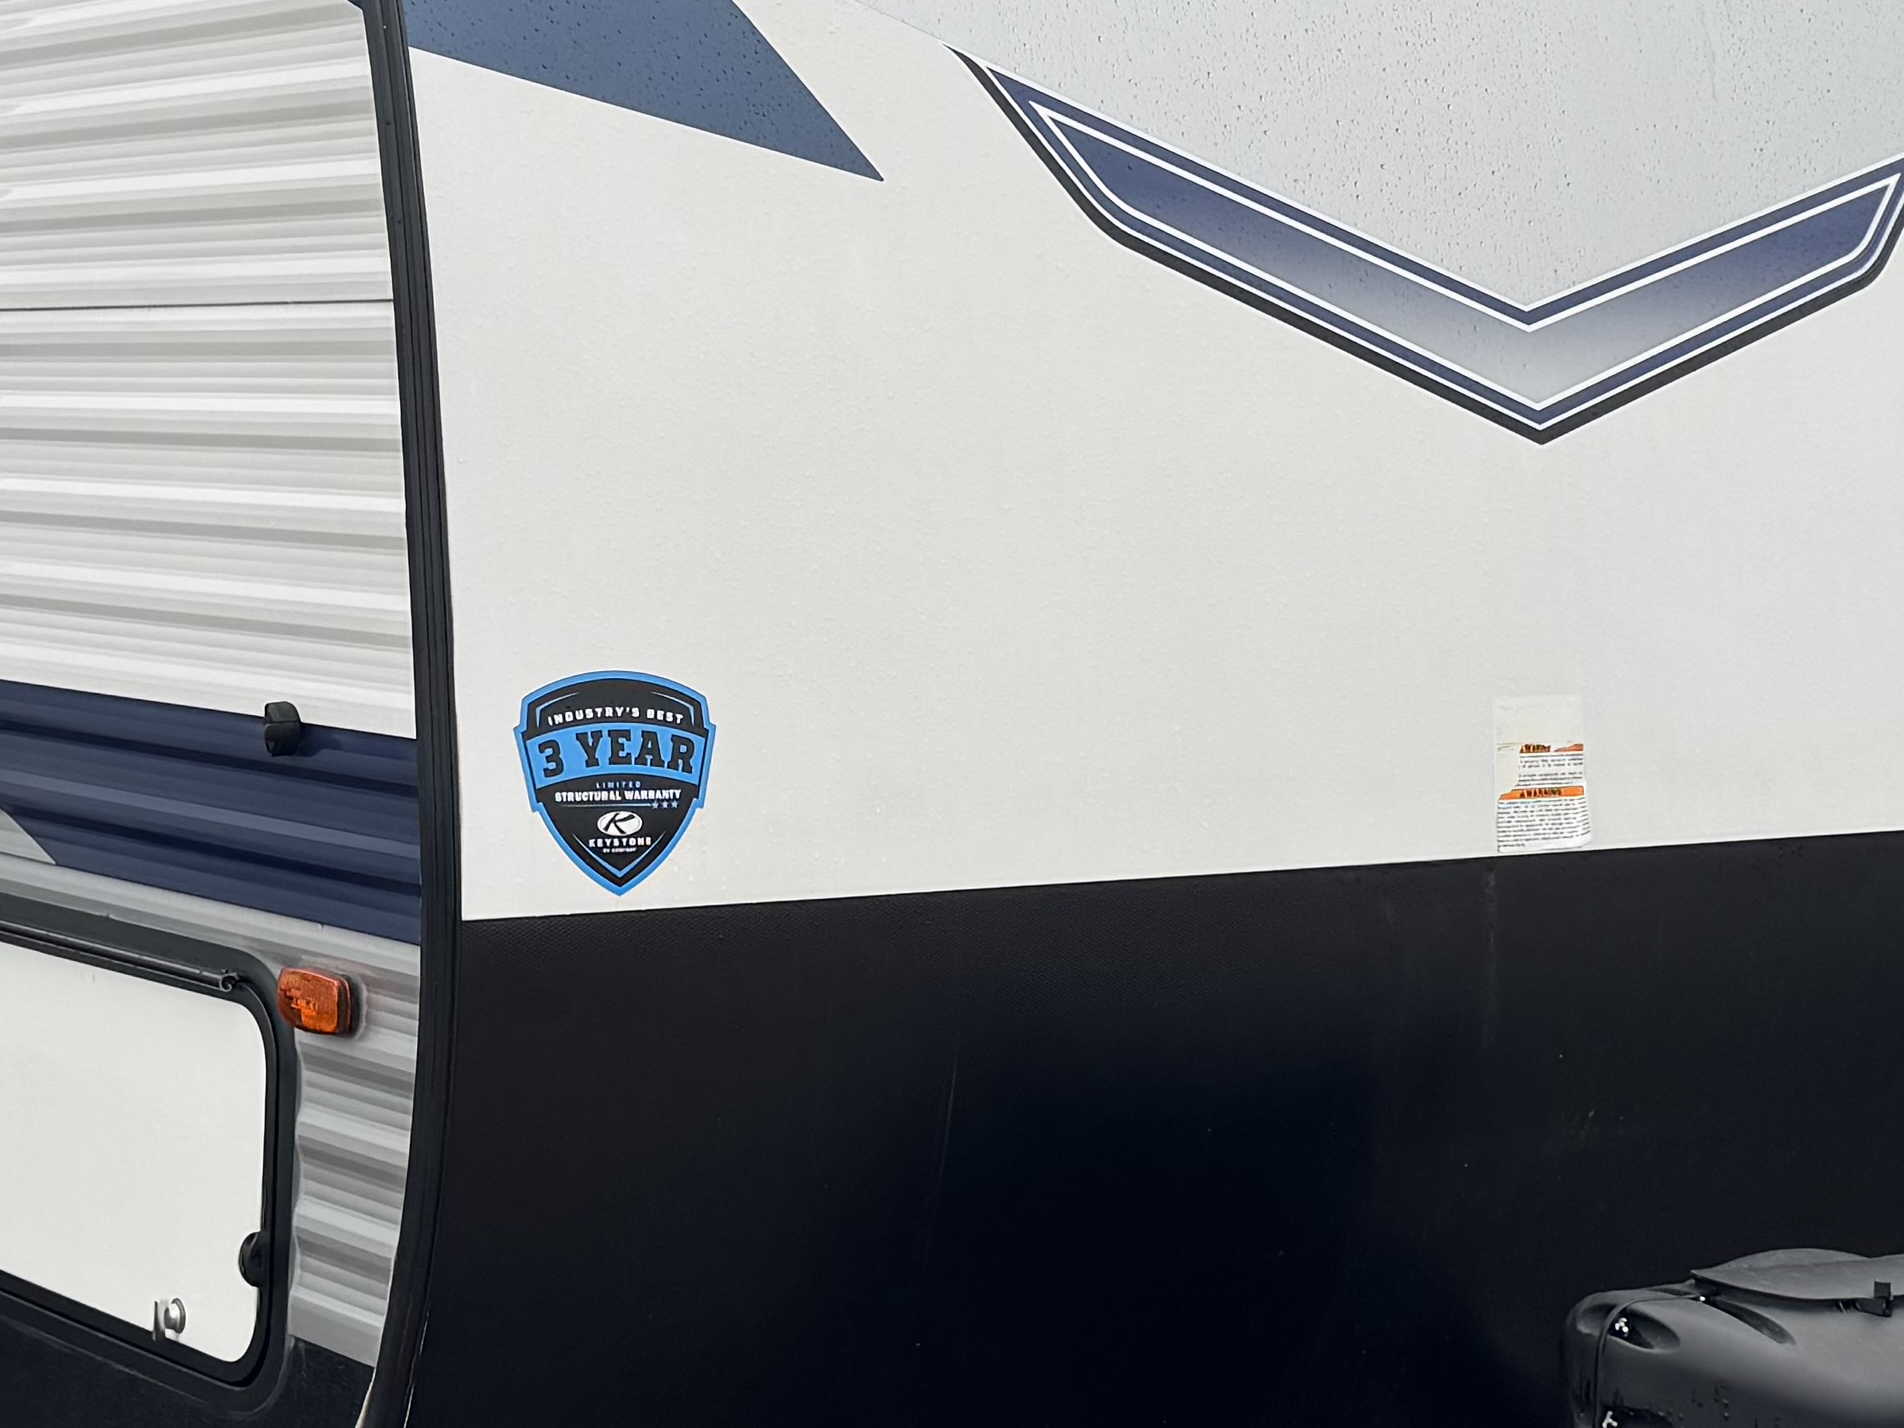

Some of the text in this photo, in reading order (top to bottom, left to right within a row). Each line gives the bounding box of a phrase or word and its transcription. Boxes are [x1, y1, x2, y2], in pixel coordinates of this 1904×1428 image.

[547, 706, 684, 726] INDUSTRY'S BEST
[537, 729, 696, 778] 3 YEAR
[554, 789, 682, 802] STRUCTURAL WARRANTY
[588, 836, 652, 848] KEYSTONE
